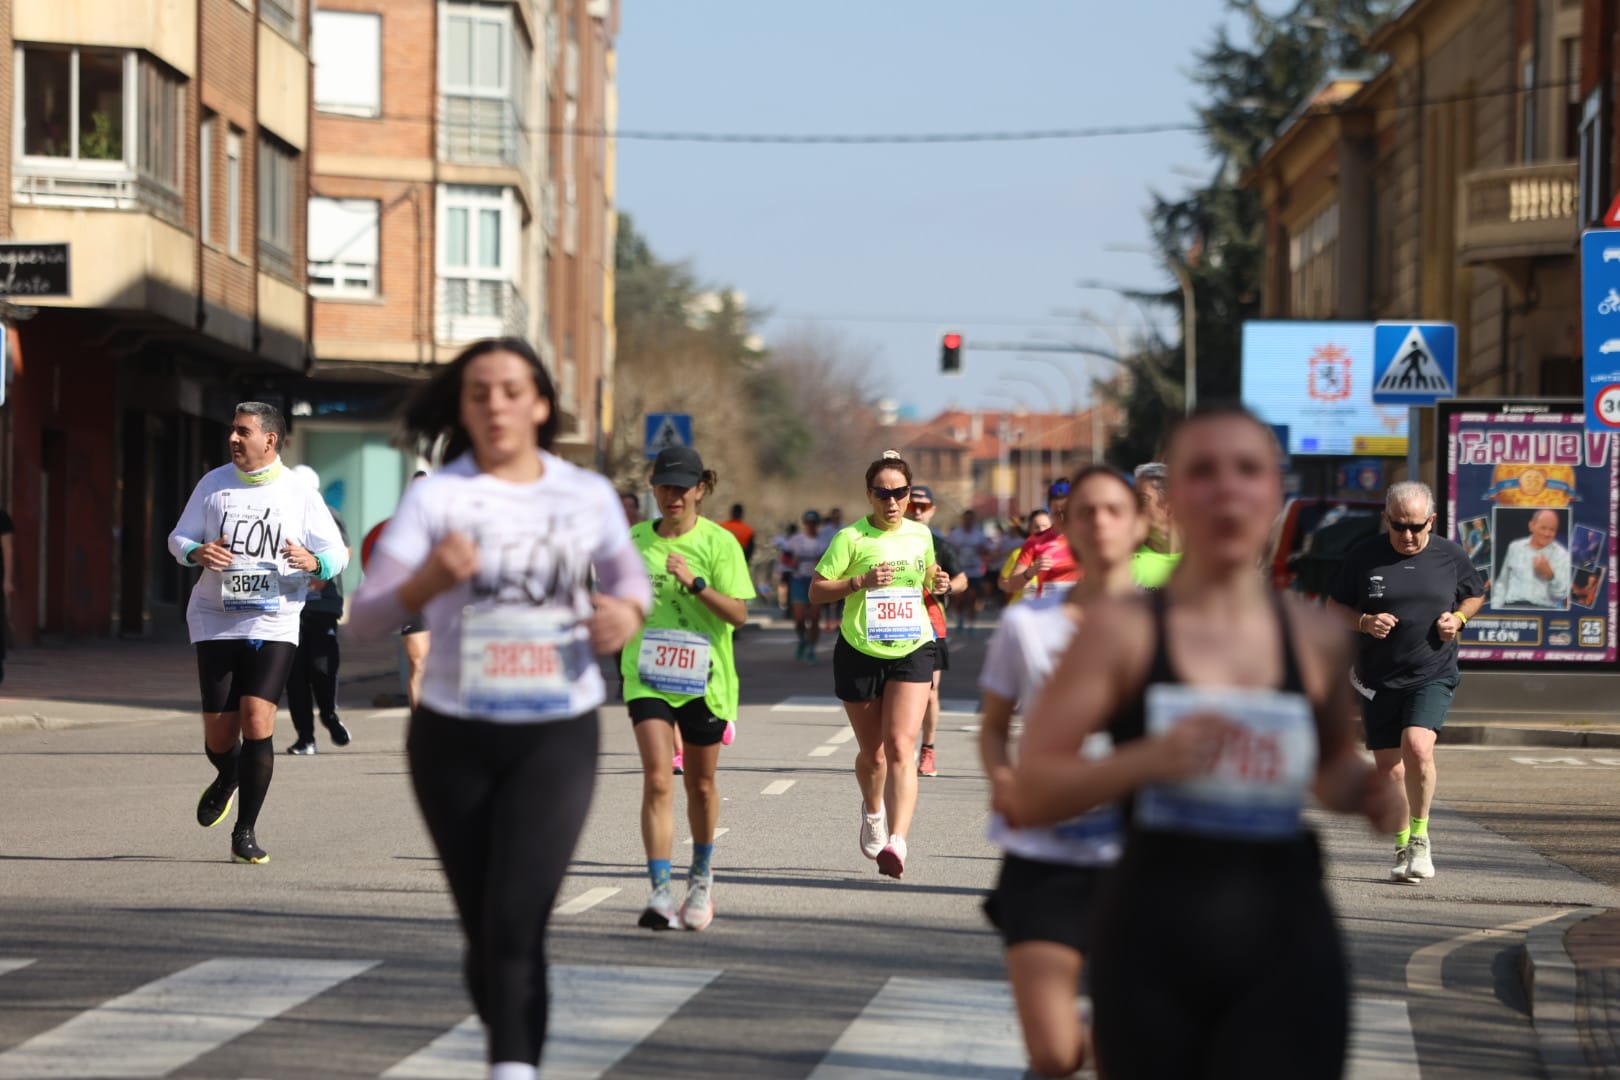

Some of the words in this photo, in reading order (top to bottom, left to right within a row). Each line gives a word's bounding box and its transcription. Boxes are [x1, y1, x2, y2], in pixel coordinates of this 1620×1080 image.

[232, 574, 270, 593] 3624
[877, 601, 913, 620] 3845
[1478, 629, 1519, 642] LEÓN
[1582, 621, 1601, 636] 25
[654, 644, 696, 670] 3761
